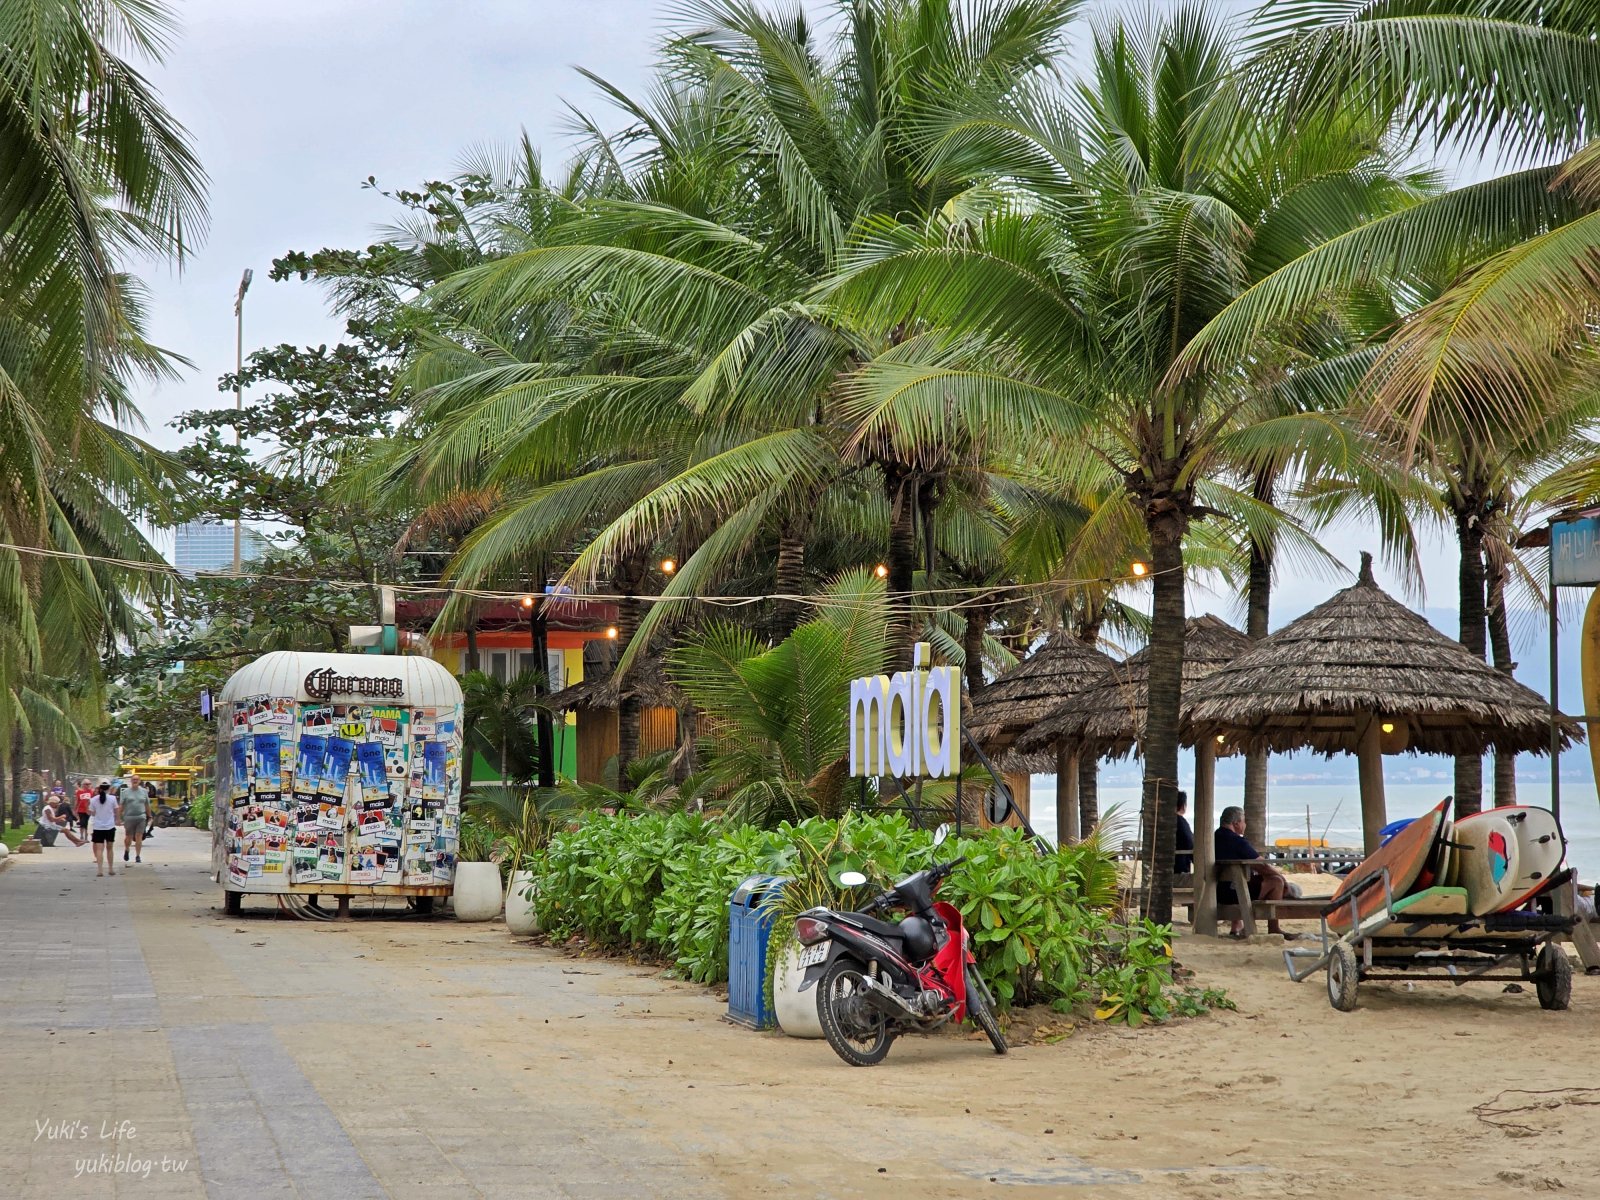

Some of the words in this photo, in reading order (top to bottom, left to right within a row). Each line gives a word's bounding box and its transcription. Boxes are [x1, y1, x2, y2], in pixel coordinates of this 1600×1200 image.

[304, 667, 404, 702] Corona
[373, 709, 402, 719] MAMA
[850, 641, 961, 778] maia
[305, 743, 324, 752] one
[332, 745, 351, 754] one
[363, 750, 381, 758] one
[321, 795, 337, 803] maia
